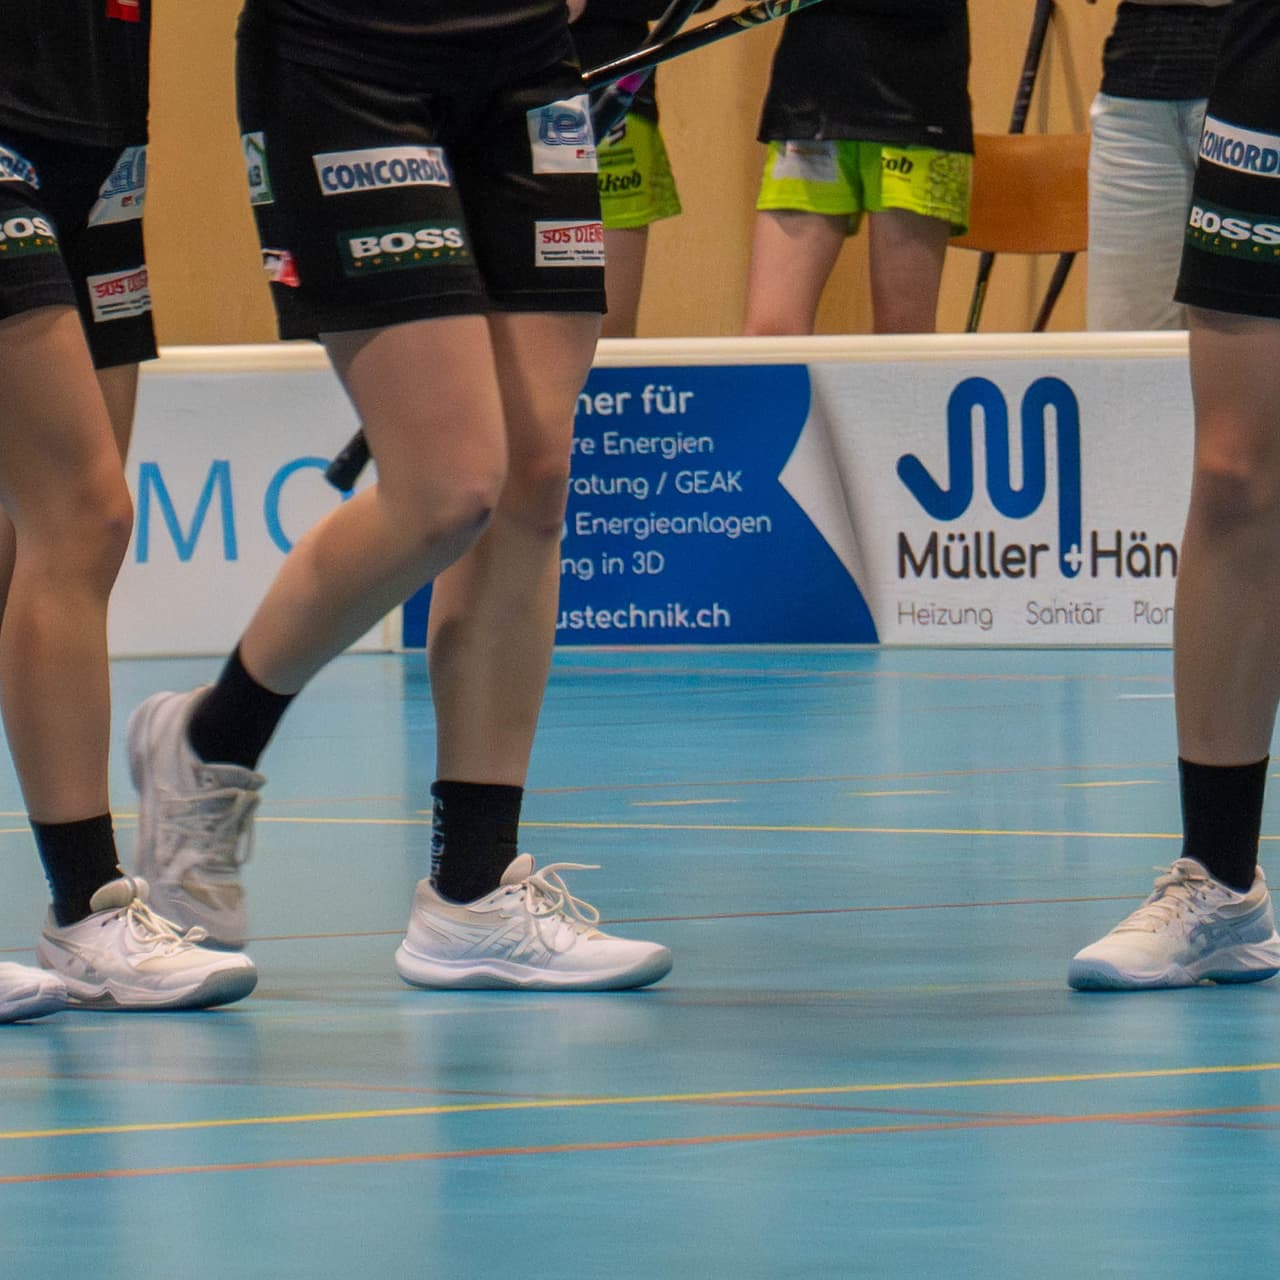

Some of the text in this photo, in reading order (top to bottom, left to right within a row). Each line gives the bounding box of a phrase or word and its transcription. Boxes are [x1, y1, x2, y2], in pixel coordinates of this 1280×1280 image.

[348, 227, 465, 259] BOSS
[542, 229, 571, 245] SOS
[641, 384, 694, 415] für
[603, 431, 714, 460] Energien
[568, 470, 743, 501] ratung / GEAK
[575, 511, 772, 540] Energieanlagen
[601, 552, 625, 575] in
[631, 551, 666, 576] 3D
[897, 531, 1051, 579] Müller
[554, 603, 732, 631] ustechnik.ch
[897, 601, 994, 631] Heizung
[1026, 600, 1105, 625] Sanitär
